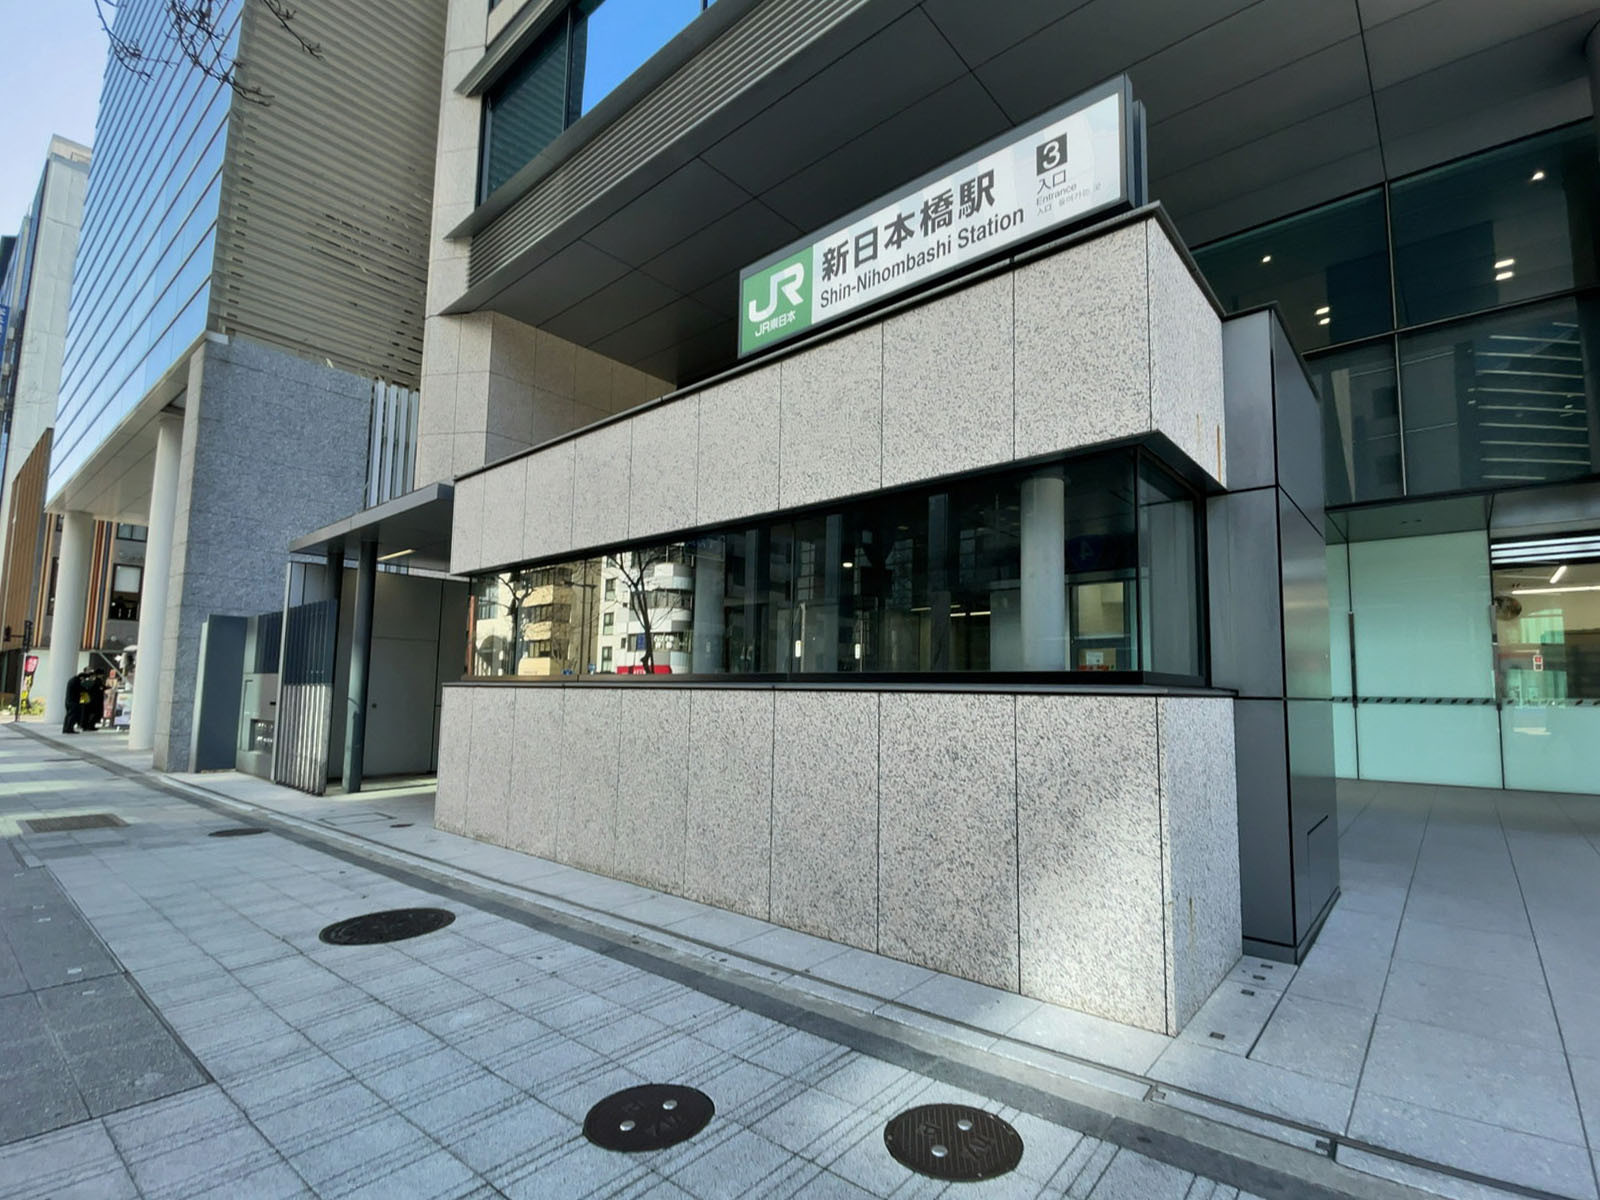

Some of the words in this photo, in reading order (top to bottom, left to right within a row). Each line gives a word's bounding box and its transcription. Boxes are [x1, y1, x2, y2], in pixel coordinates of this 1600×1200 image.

[1042, 140, 1061, 170] 3
[1036, 183, 1077, 207] Entrance
[1037, 169, 1066, 195] 入口
[821, 168, 996, 283] 新日本橋駅
[820, 240, 952, 308] Shin-Nihombashi
[958, 207, 1025, 249] Station
[748, 262, 805, 323] JR
[754, 310, 797, 337] JR東日本
